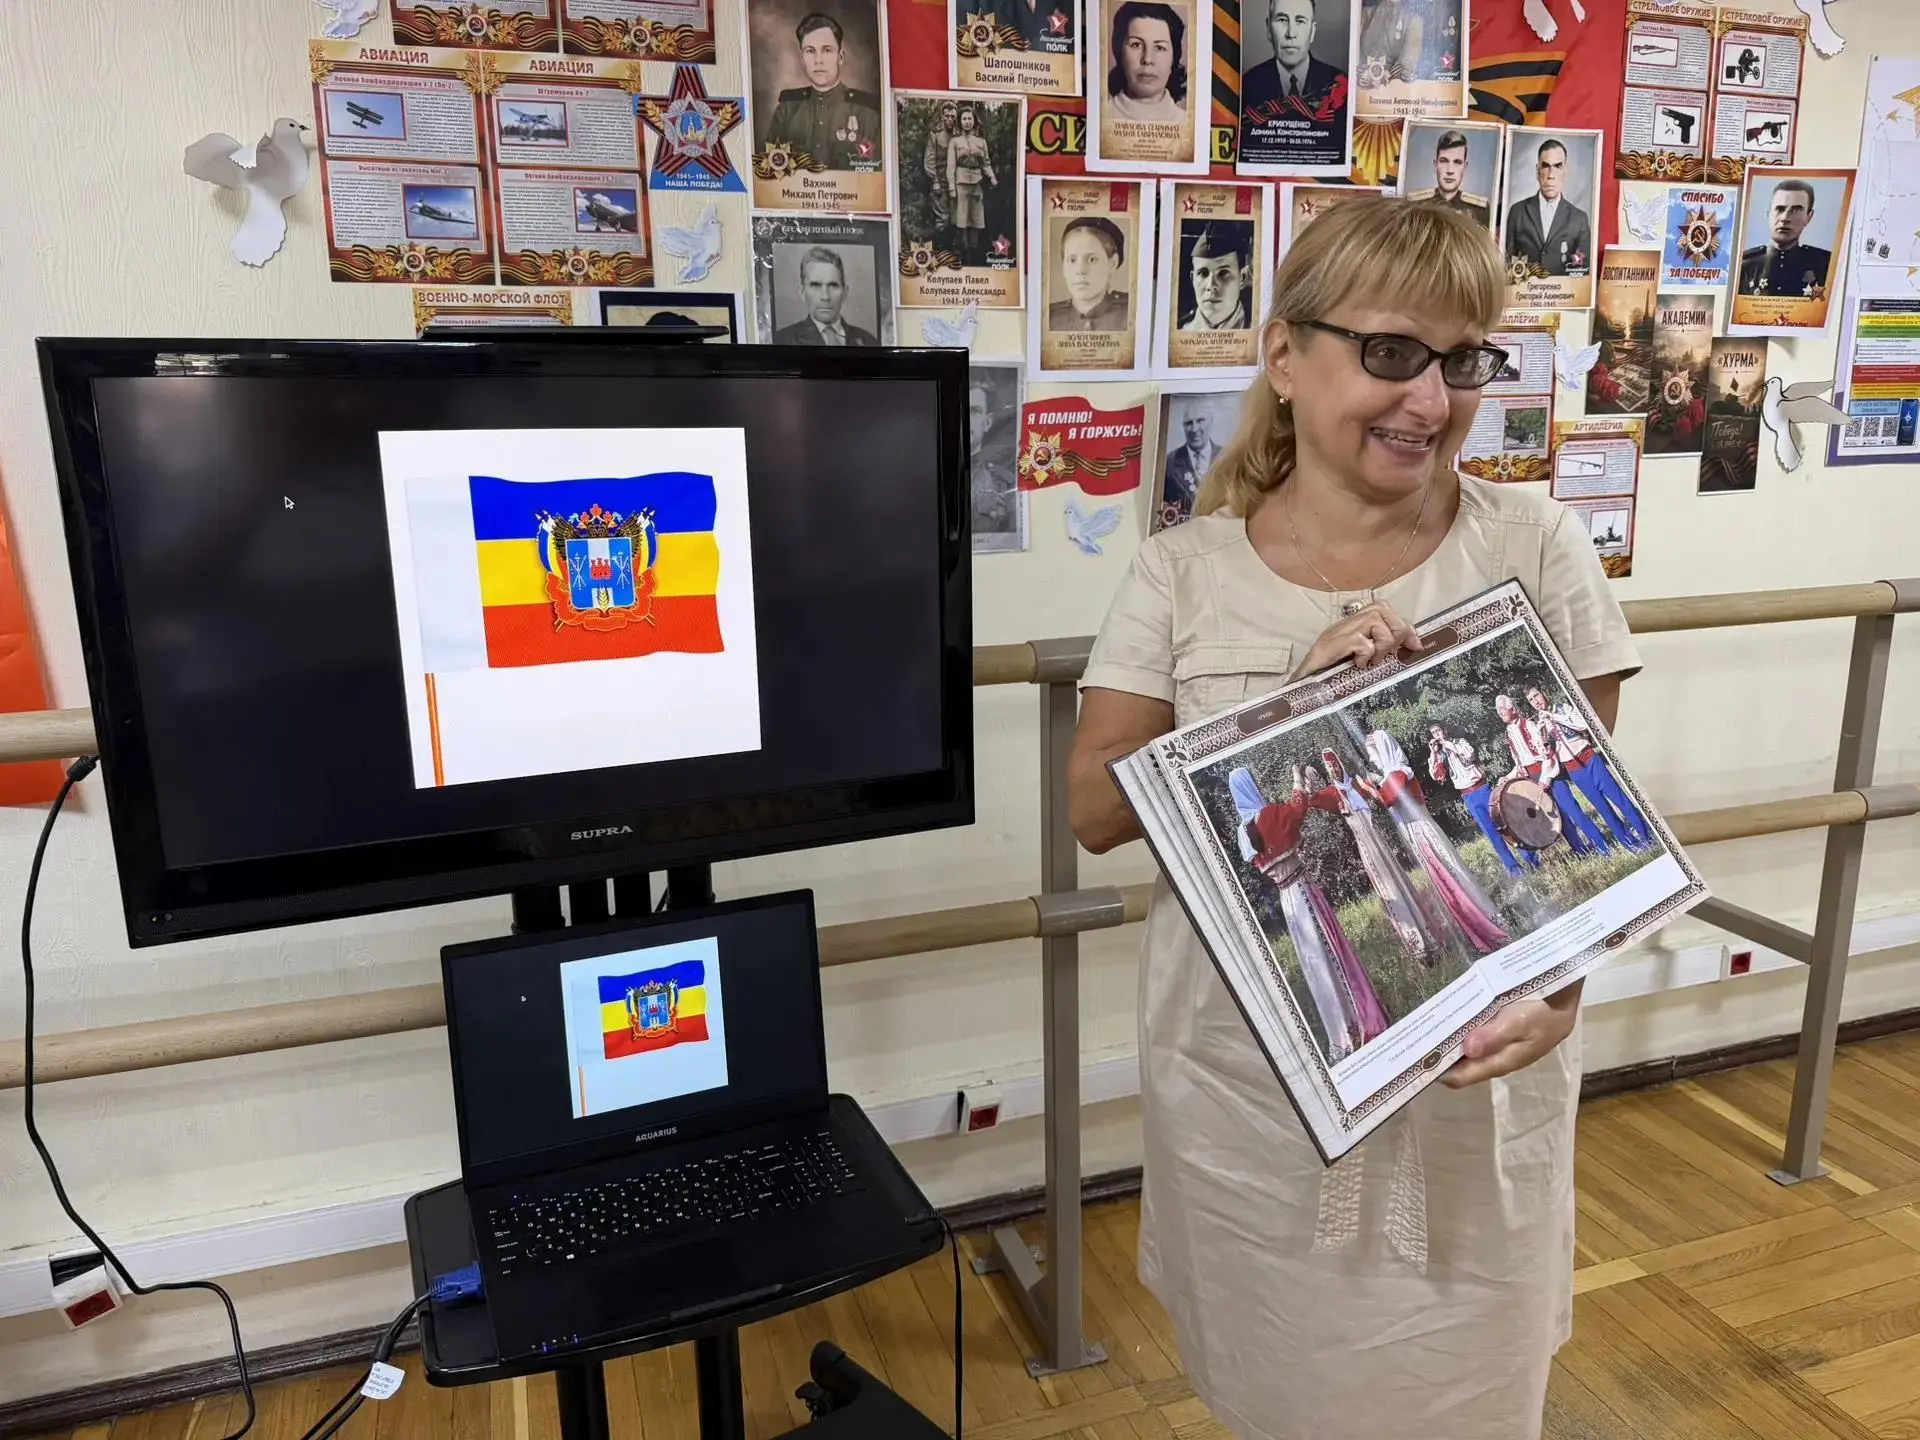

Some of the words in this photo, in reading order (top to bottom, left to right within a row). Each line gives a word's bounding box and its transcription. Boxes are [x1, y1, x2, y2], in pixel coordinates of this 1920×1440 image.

[1681, 7, 1711, 17] ОРУЖИЕ
[1726, 11, 1771, 23] СТРЕЛКОВОЕ
[1773, 16, 1803, 26] ОРУЖИЕ
[1046, 44, 1068, 52] ПОЛК
[359, 48, 429, 64] АВИАЦИЯ
[530, 60, 594, 75] АВИАЦИЯ
[984, 57, 1051, 72] Шапошников
[975, 72, 1015, 83] Василий
[1018, 74, 1060, 87] Петрович
[690, 181, 723, 189] ПОБЕДА!
[803, 178, 837, 188] Вахнин
[782, 189, 816, 200] Михаил
[817, 190, 858, 202] Петрович
[1681, 191, 1725, 204] СПАСИБО
[802, 201, 840, 209] 1941-1945
[927, 275, 963, 286] Колупаев
[965, 275, 989, 284] Павел
[1602, 266, 1656, 281] ВОСПИТАННИКИ
[1669, 267, 1681, 278] ЗА
[1683, 267, 1721, 281] ПОБЕДУ!
[920, 286, 960, 296] Колупаева
[961, 287, 1006, 297] Александра
[1527, 281, 1562, 291] Григоренко
[419, 291, 531, 304] ВОЕННО-МОРСКОЙ
[534, 293, 566, 305] ФЛОТ
[942, 297, 980, 305] 1941-195
[1516, 291, 1542, 301] Григорий
[1661, 311, 1706, 325] АКАДЕМИИ
[1717, 352, 1759, 368] «ХУРМА»
[1028, 412, 1036, 425] Я
[1039, 411, 1093, 425] ПОМНЮ!
[1068, 427, 1077, 440] Я
[1080, 424, 1143, 440] ГОРЖУСЬ!
[1574, 421, 1623, 431] АРТИЛЛЕРИЯ
[570, 825, 633, 841] SUPRA
[635, 1126, 678, 1143] AQUARIUS
